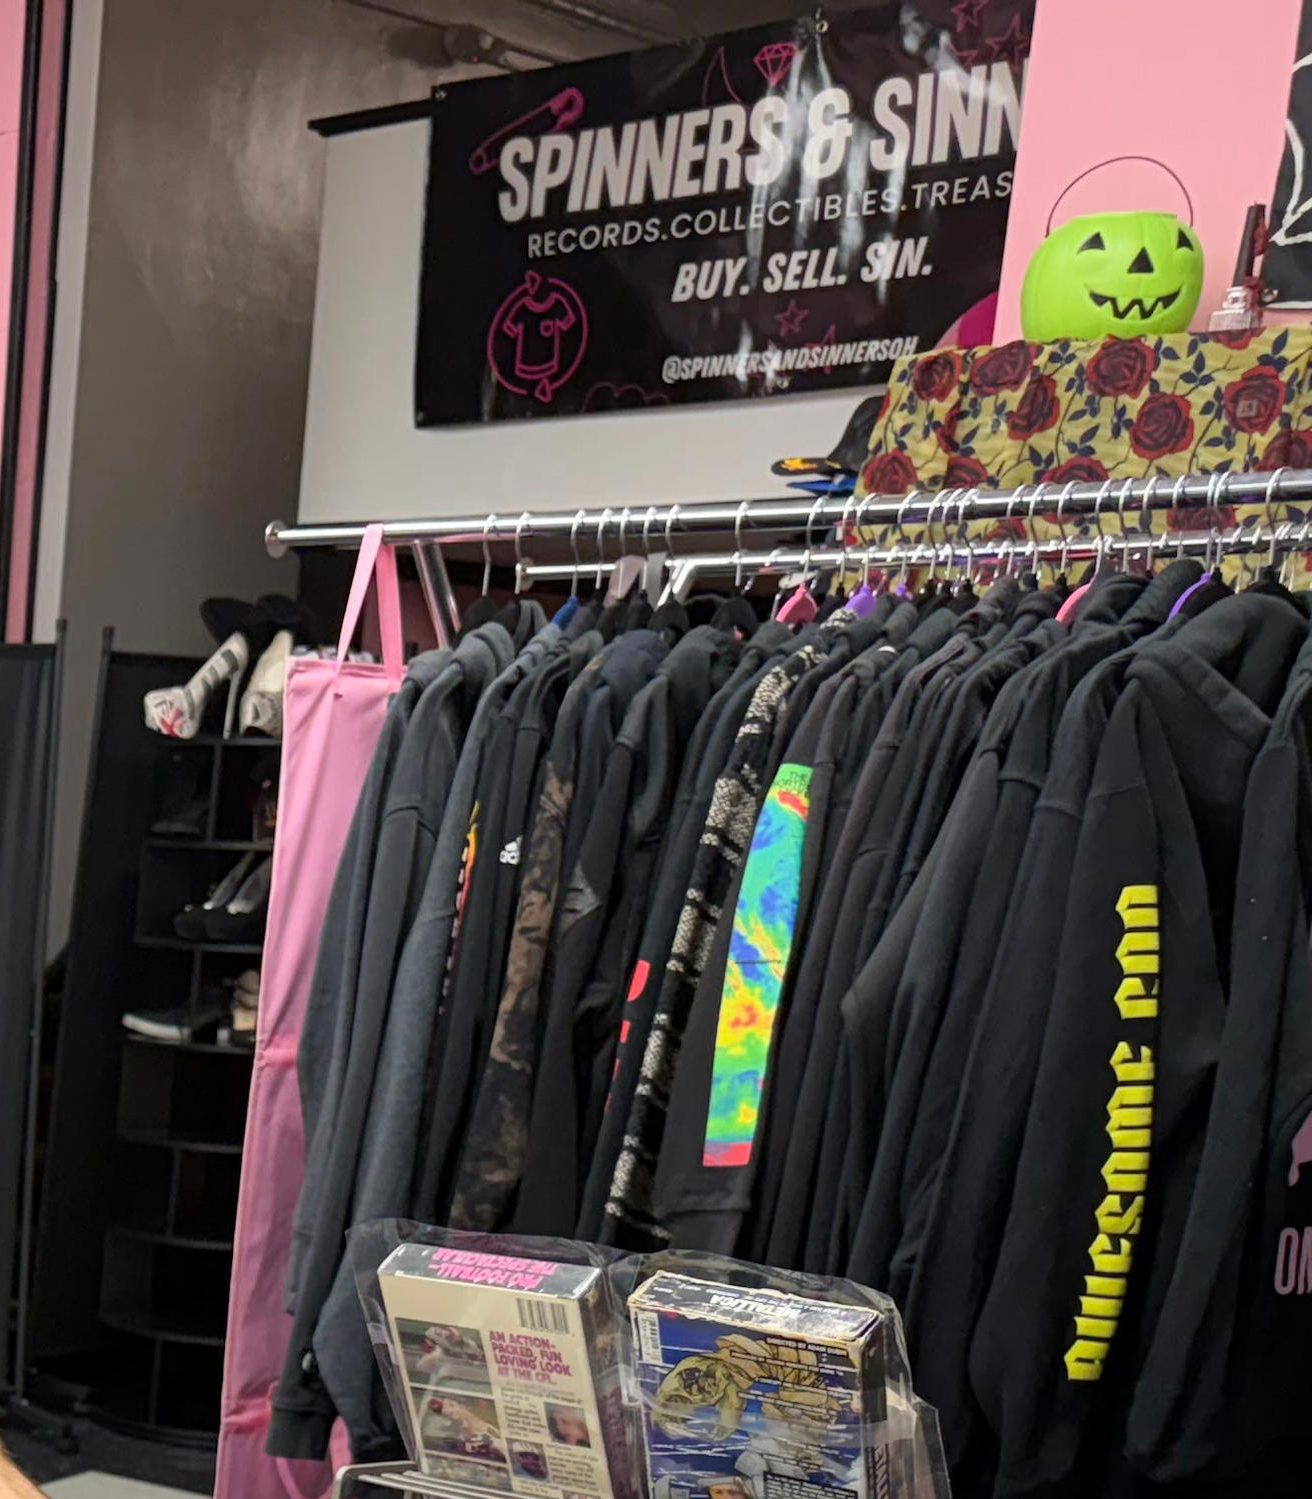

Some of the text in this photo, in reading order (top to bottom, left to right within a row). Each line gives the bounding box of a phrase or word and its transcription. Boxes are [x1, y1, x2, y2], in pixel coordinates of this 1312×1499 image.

[498, 95, 788, 223] SPINNERS
[803, 87, 853, 180] &
[671, 235, 934, 304] BUY. SELL. SIN.
[661, 335, 920, 385] @SPINNERSANDSINNERSOH
[508, 1271, 544, 1290] PRO
[489, 1330, 557, 1350] AN ACTION-
[494, 1354, 572, 1377] LOVING LOOK
[540, 1349, 563, 1363] FUN
